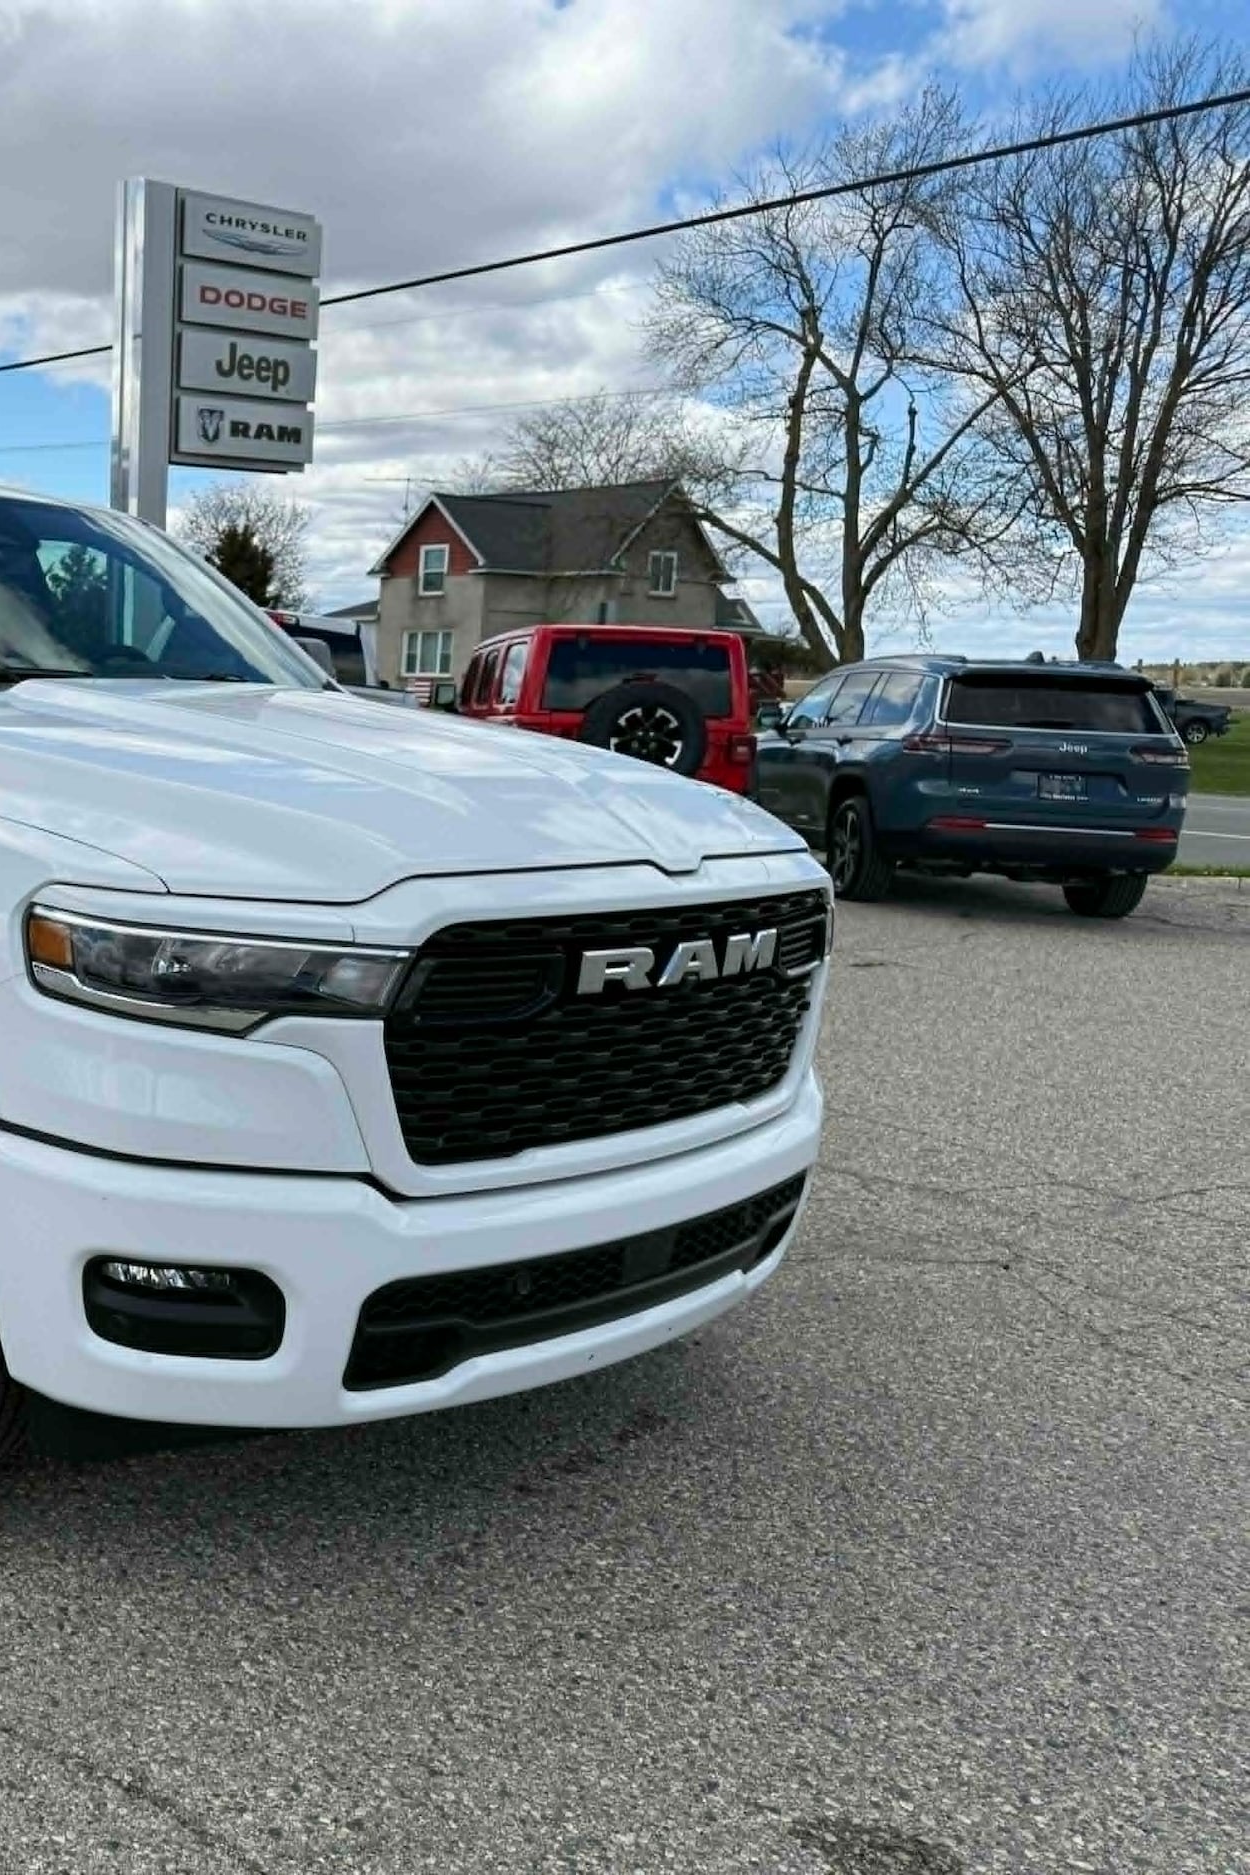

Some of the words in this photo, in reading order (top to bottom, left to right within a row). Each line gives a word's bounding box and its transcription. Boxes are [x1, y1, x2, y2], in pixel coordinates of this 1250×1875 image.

[205, 212, 308, 242] CHRYSLER
[199, 285, 308, 320] DODGE
[215, 341, 291, 392] Jeep
[230, 419, 303, 445] RAM
[577, 928, 778, 995] RAM
